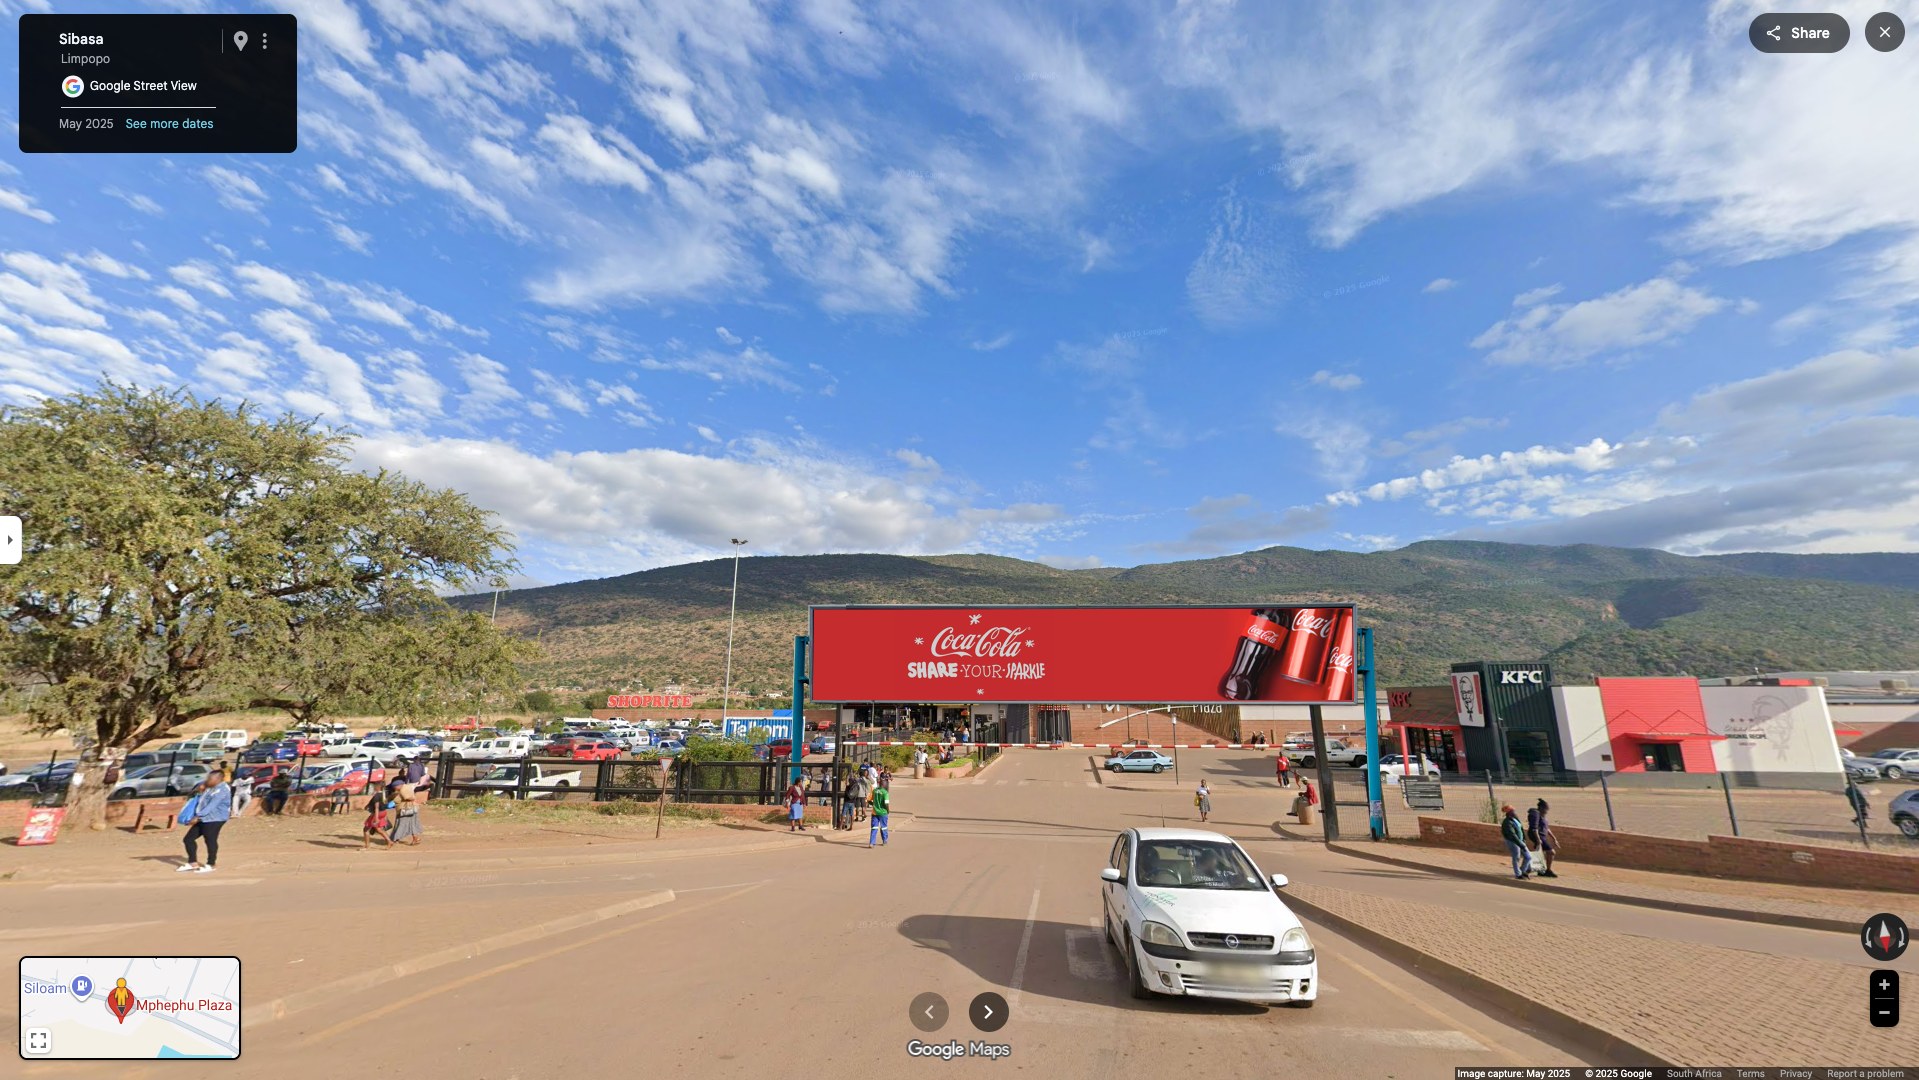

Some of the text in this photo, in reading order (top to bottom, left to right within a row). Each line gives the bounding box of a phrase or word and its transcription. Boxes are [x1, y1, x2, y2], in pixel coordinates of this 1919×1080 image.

[930, 626, 1028, 658] Coca-Cola
[907, 661, 1046, 680] SHARE YOUR SPARKLE
[1500, 670, 1543, 684] KFC
[607, 694, 693, 708] SHOPRITE
[1389, 691, 1411, 707] KFC
